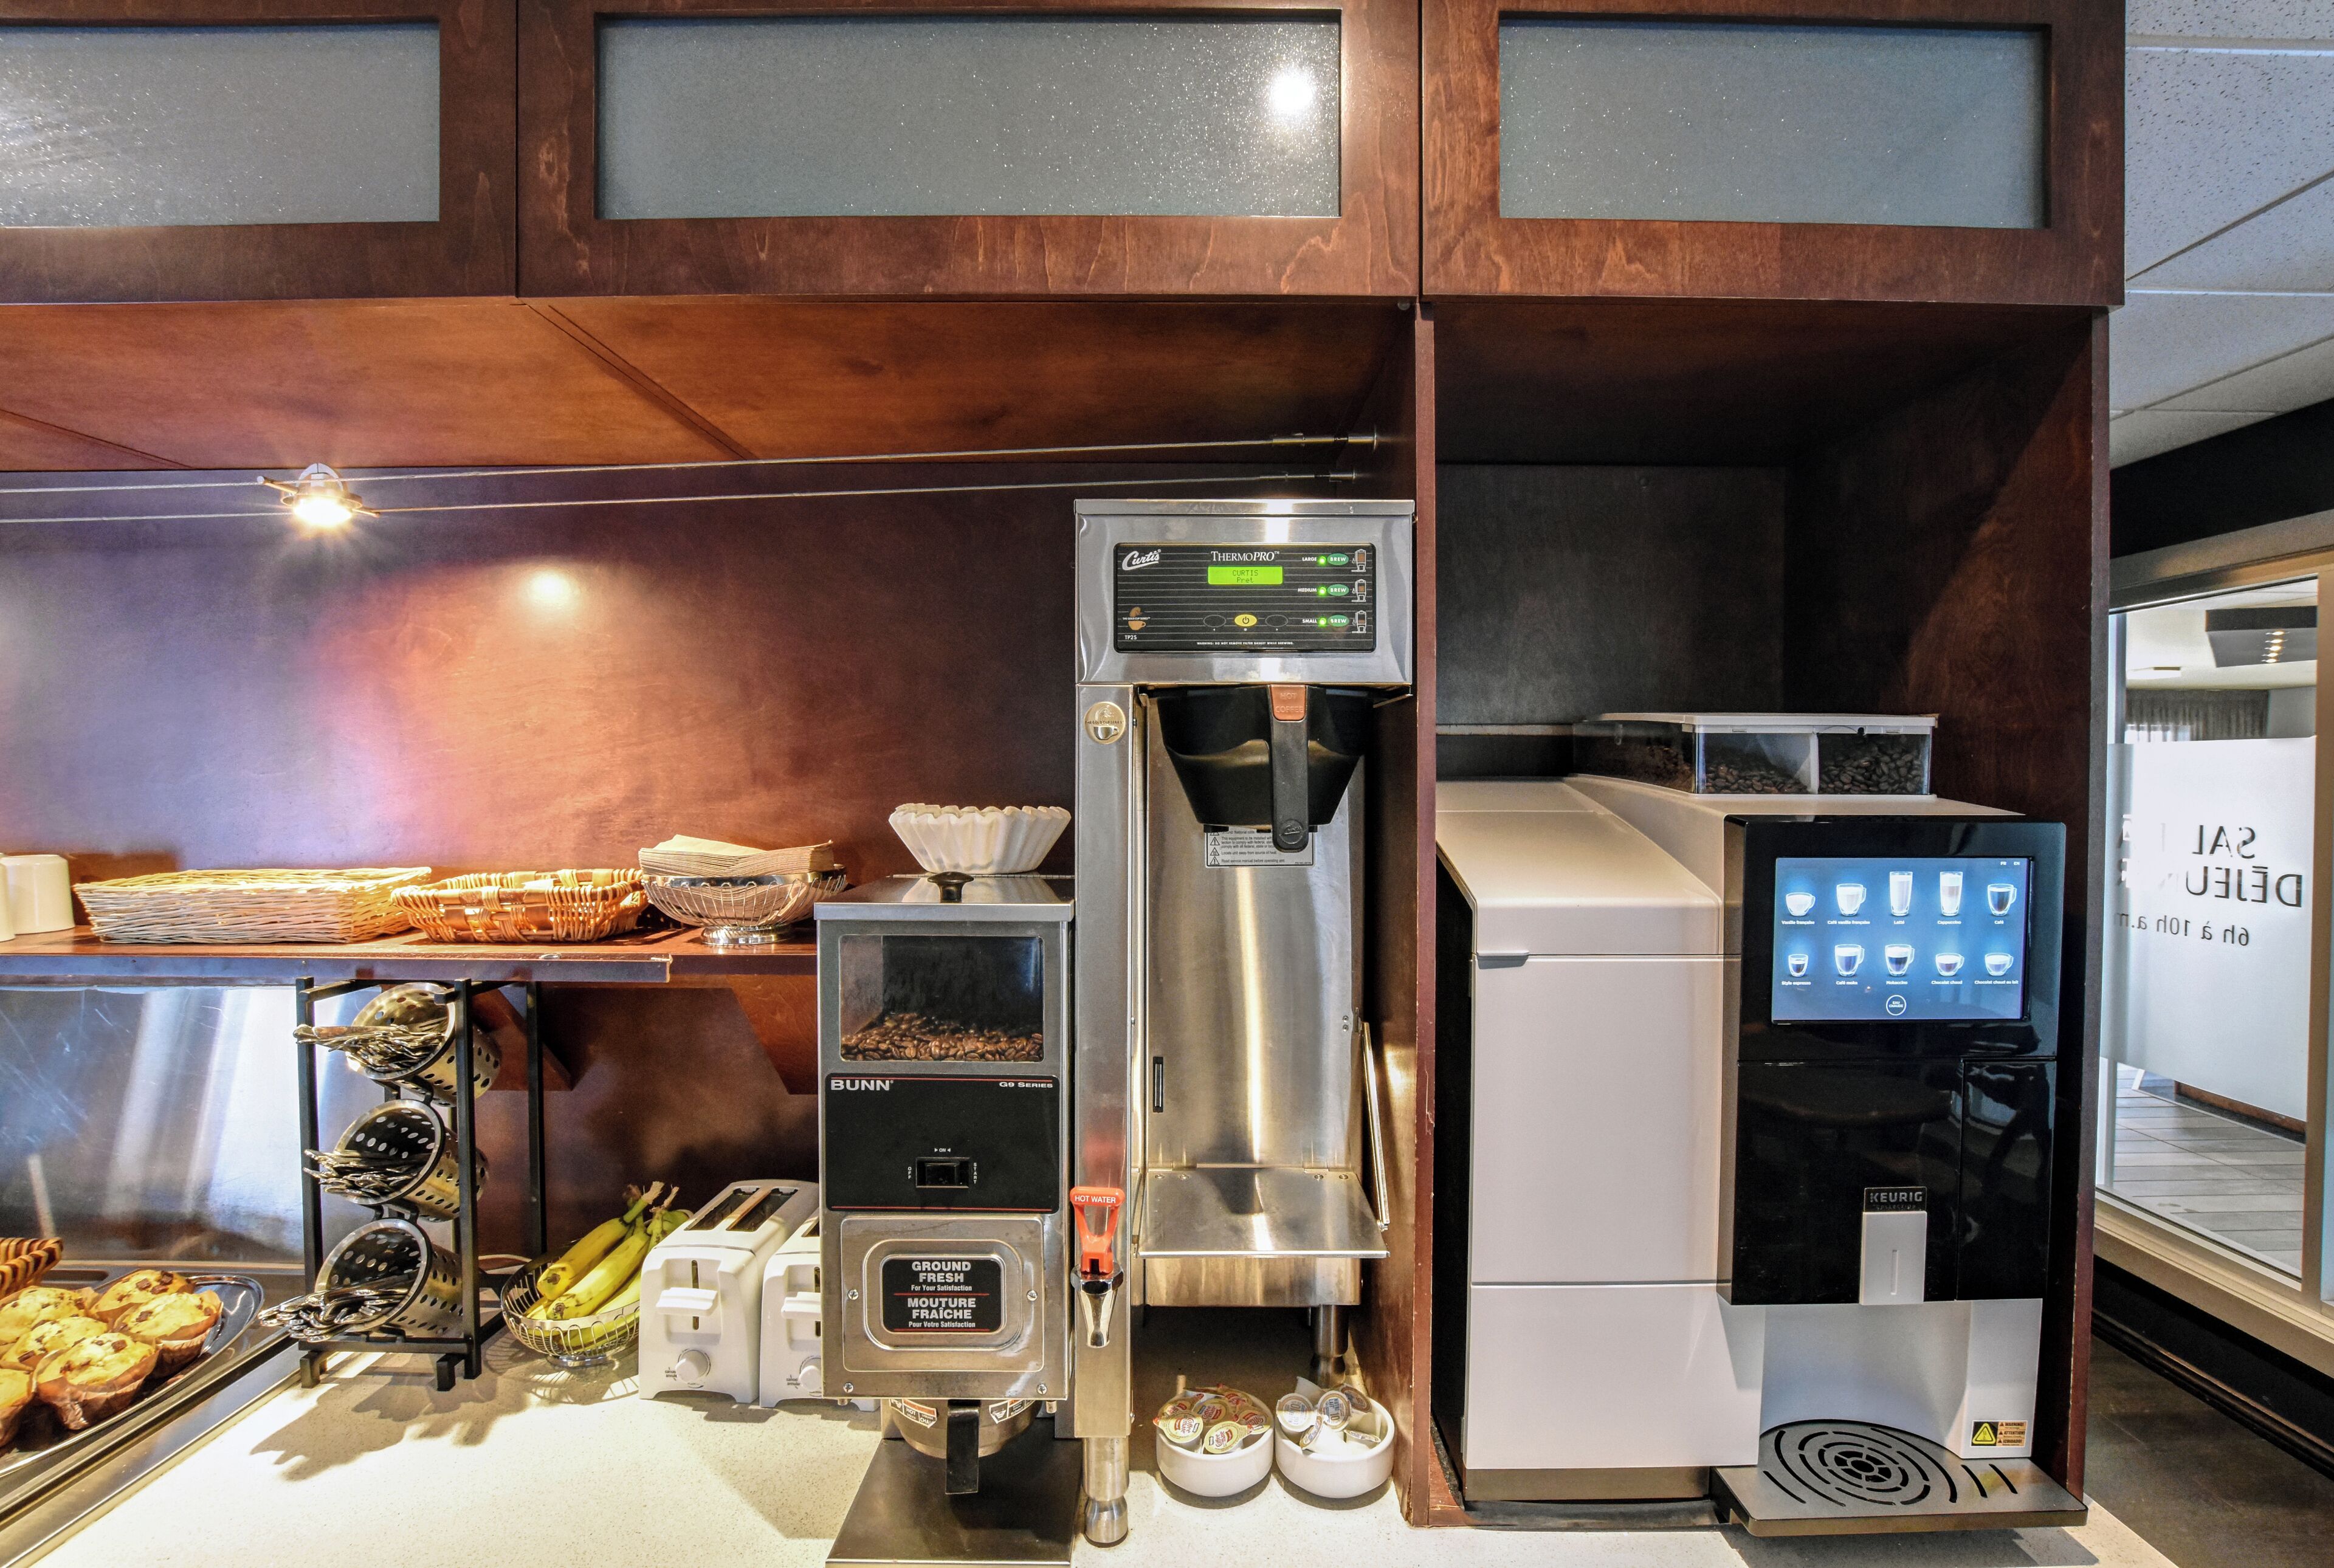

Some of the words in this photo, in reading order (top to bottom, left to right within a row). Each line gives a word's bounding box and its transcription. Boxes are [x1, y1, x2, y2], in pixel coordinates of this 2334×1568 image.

[1122, 551, 1160, 570] Curtis
[831, 1079, 890, 1091] BUNN
[1870, 1192, 1923, 1203] KEURIG
[912, 1261, 971, 1271] GROUND
[919, 1273, 964, 1282] FRESH
[907, 1298, 976, 1308] MOUTURE
[912, 1307, 972, 1319] FRAÎCHE
[906, 1407, 916, 1415] HOT
[1186, 1418, 1194, 1434] Coffee
